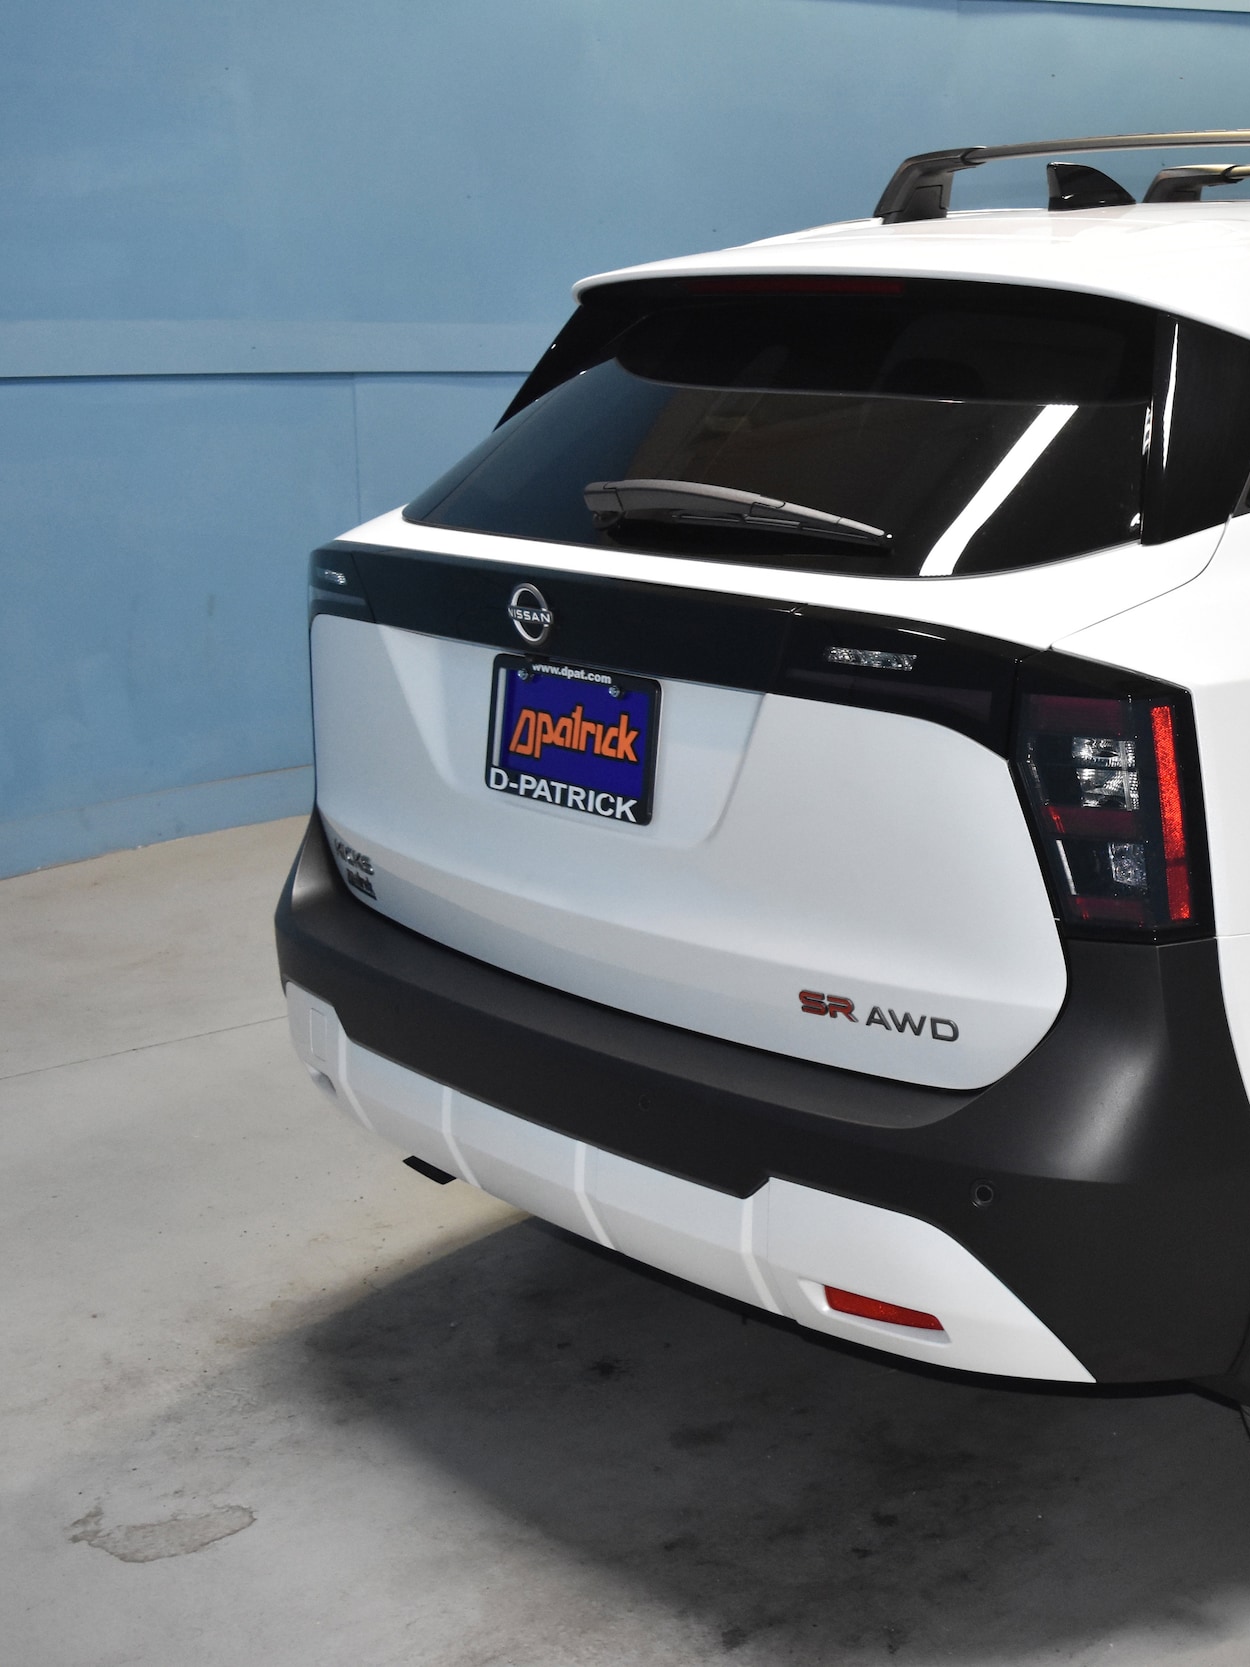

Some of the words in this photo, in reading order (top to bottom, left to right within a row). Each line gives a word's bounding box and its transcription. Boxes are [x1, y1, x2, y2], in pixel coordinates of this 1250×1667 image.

[508, 607, 551, 623] NISSAN
[532, 664, 612, 684] www.dpat.com
[489, 767, 638, 822] D-PATRICK
[798, 989, 859, 1022] SR
[865, 1006, 959, 1042] AWD
